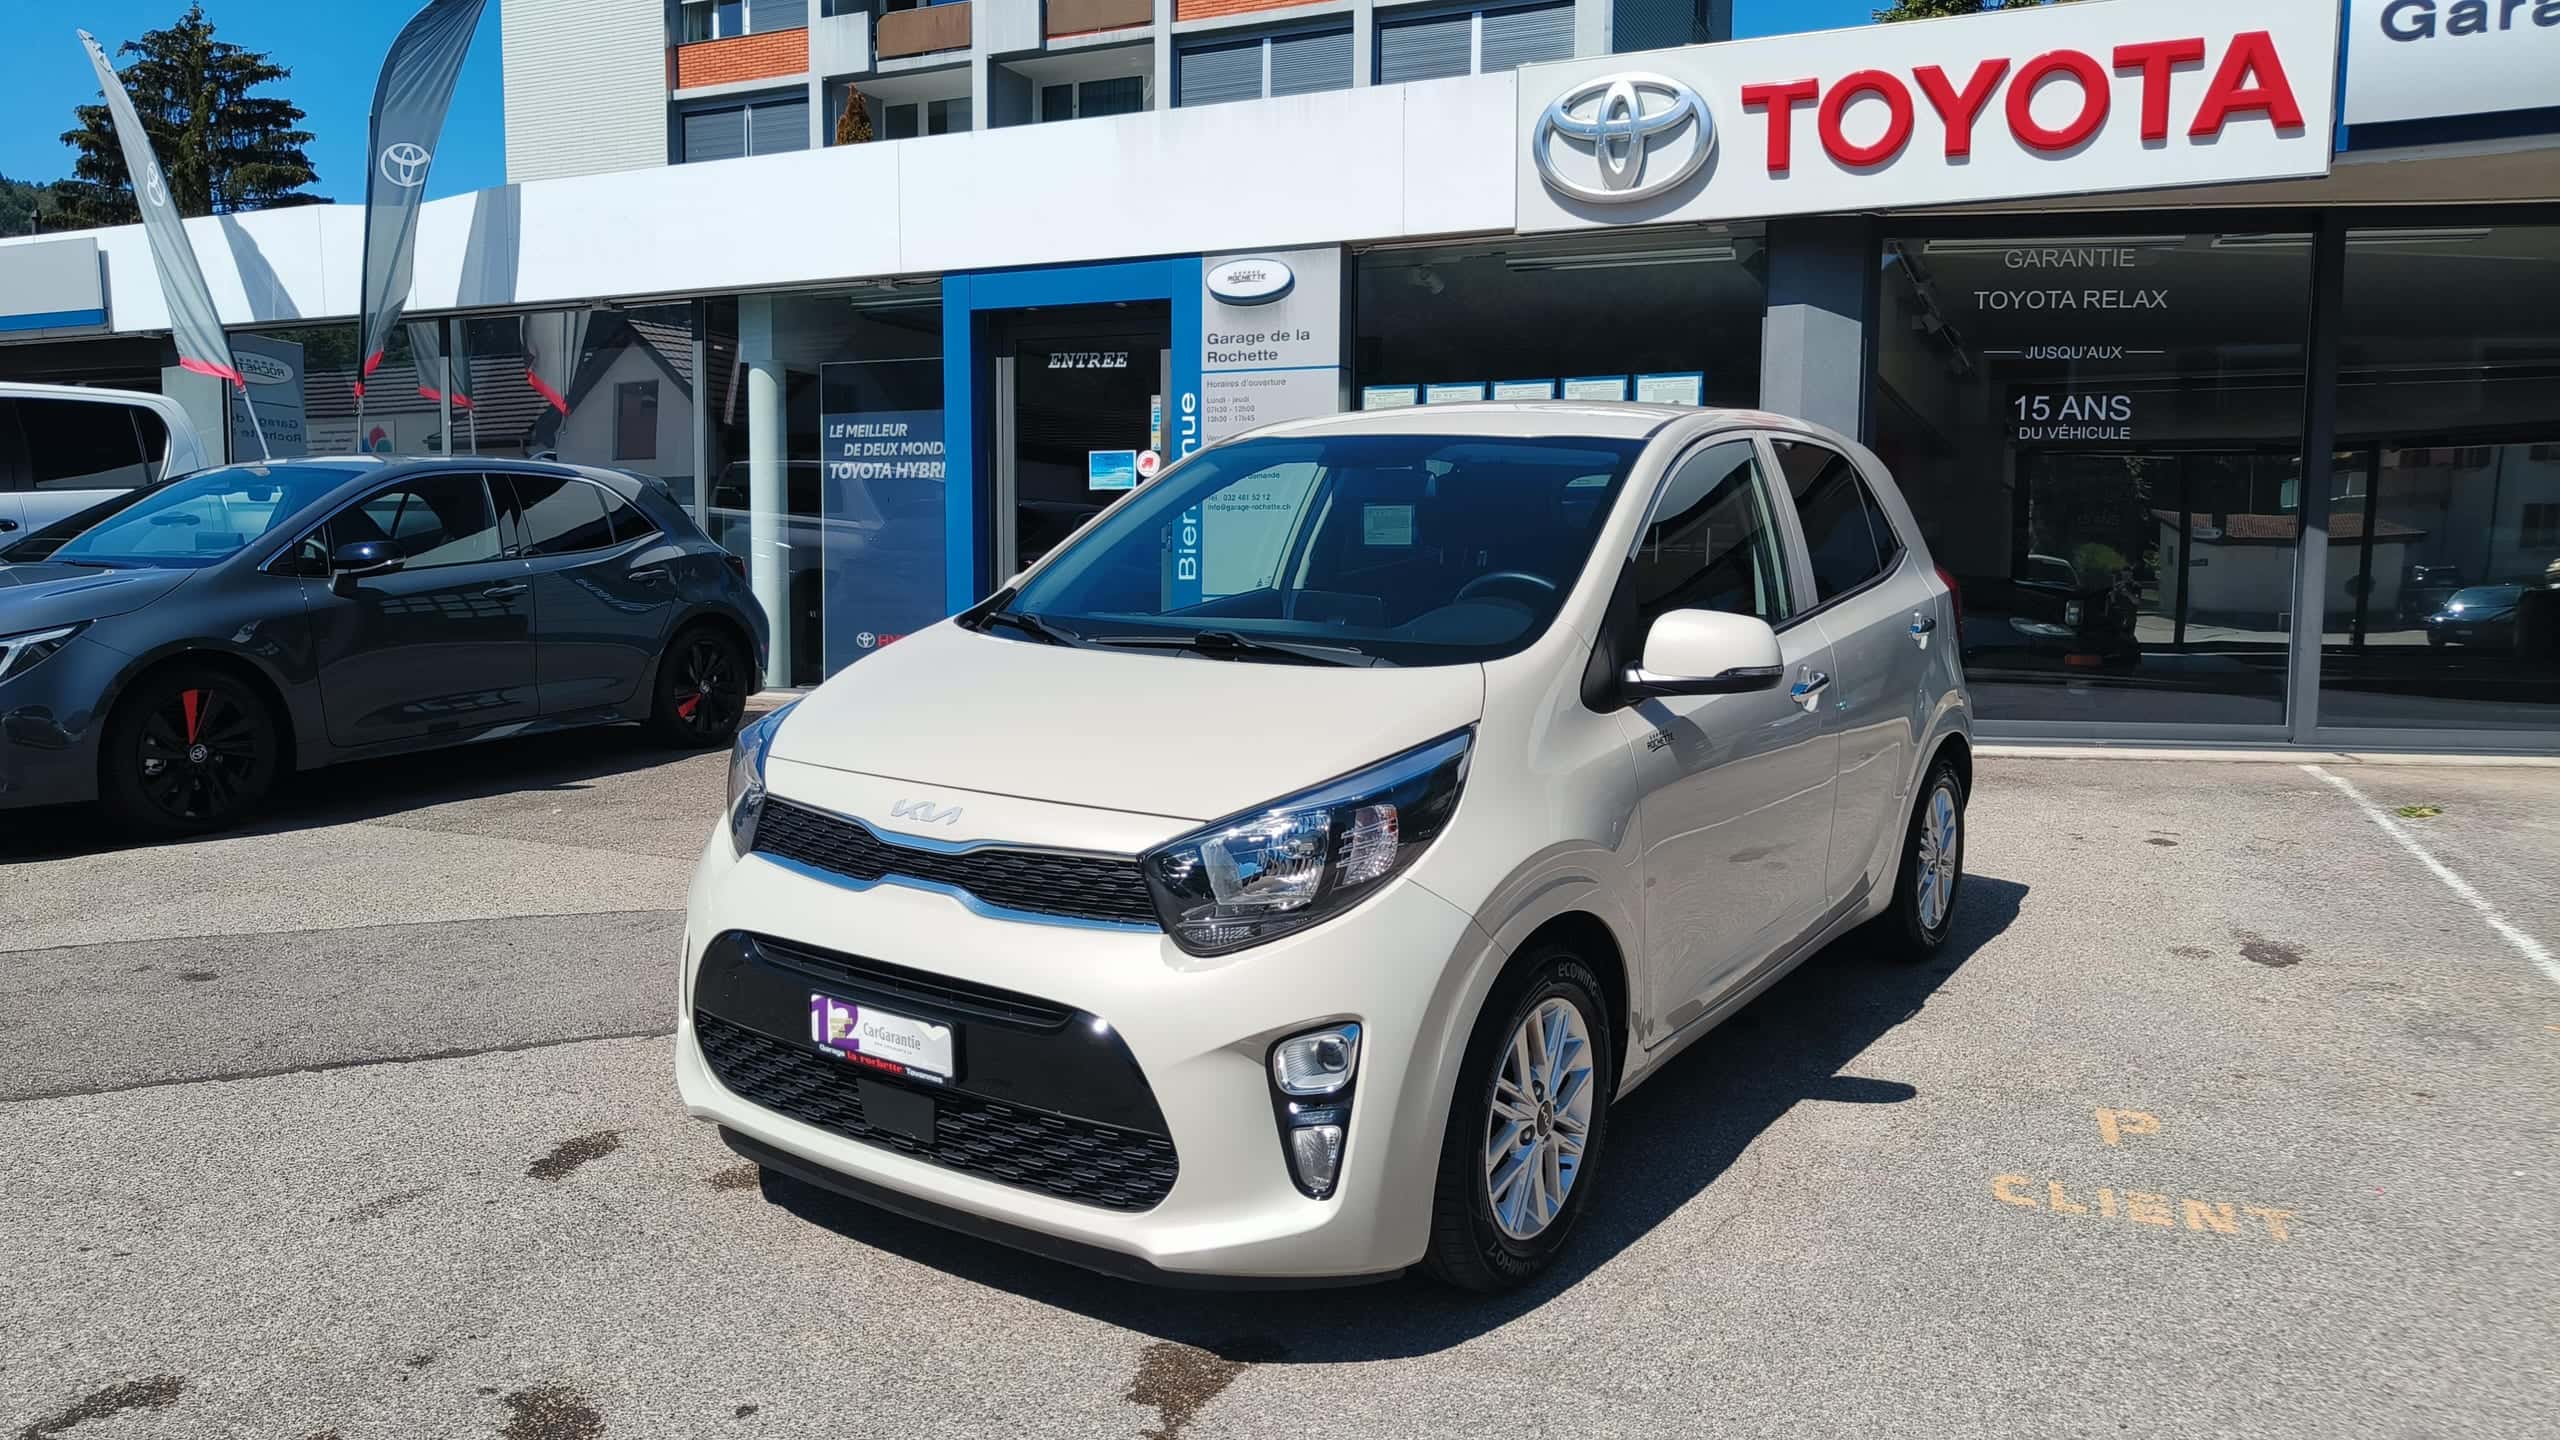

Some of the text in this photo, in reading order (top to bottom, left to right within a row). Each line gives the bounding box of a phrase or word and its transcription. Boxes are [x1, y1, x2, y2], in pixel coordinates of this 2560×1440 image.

[1742, 31, 2305, 171] TOYOTA
[2004, 248, 2136, 268] GARANTIE
[1974, 290, 2168, 309] TOYOTA RELAX
[1207, 329, 1311, 346] Garage de la
[1048, 352, 1128, 368] ENTREE
[1207, 350, 1278, 363] Rochette
[2025, 345, 2122, 360] JUSQU'AUX
[2014, 395, 2131, 421] 15 ANS
[829, 424, 908, 438] LE MEILLEUR
[2019, 423, 2131, 440] DU VÉHICULE
[844, 441, 946, 457] DE DEUX MOND
[829, 462, 892, 479] TOYOTA
[863, 1022, 921, 1050] CarGarantie
[2096, 1106, 2160, 1146] P
[1992, 1174, 2296, 1242] CLIENT
